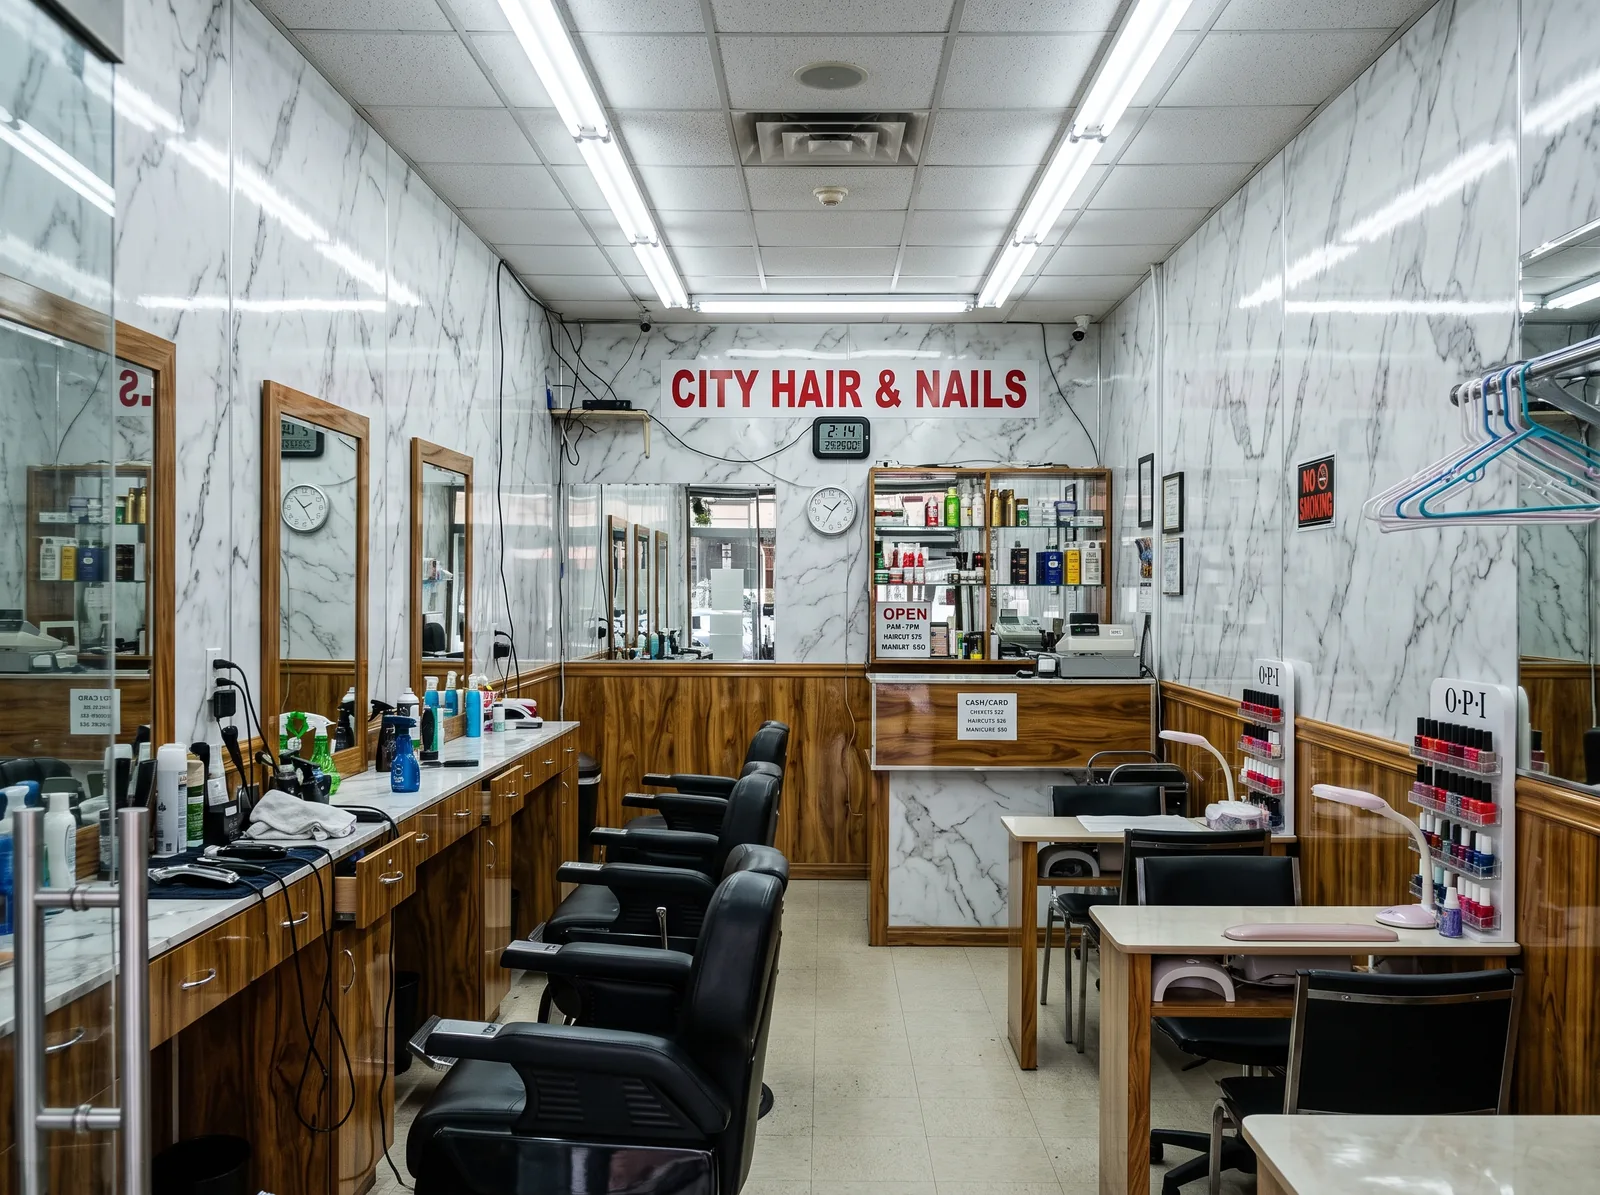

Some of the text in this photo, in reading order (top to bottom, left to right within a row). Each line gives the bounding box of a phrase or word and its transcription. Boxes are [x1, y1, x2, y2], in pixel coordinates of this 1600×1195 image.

[671, 368, 1028, 409] CITY HAIR & NAILS
[828, 425, 855, 437] 2:14
[1302, 468, 1316, 494] NO
[1299, 491, 1333, 521] SMOKING
[883, 607, 927, 620] OPEN
[965, 699, 1009, 707] CASH/CARD
